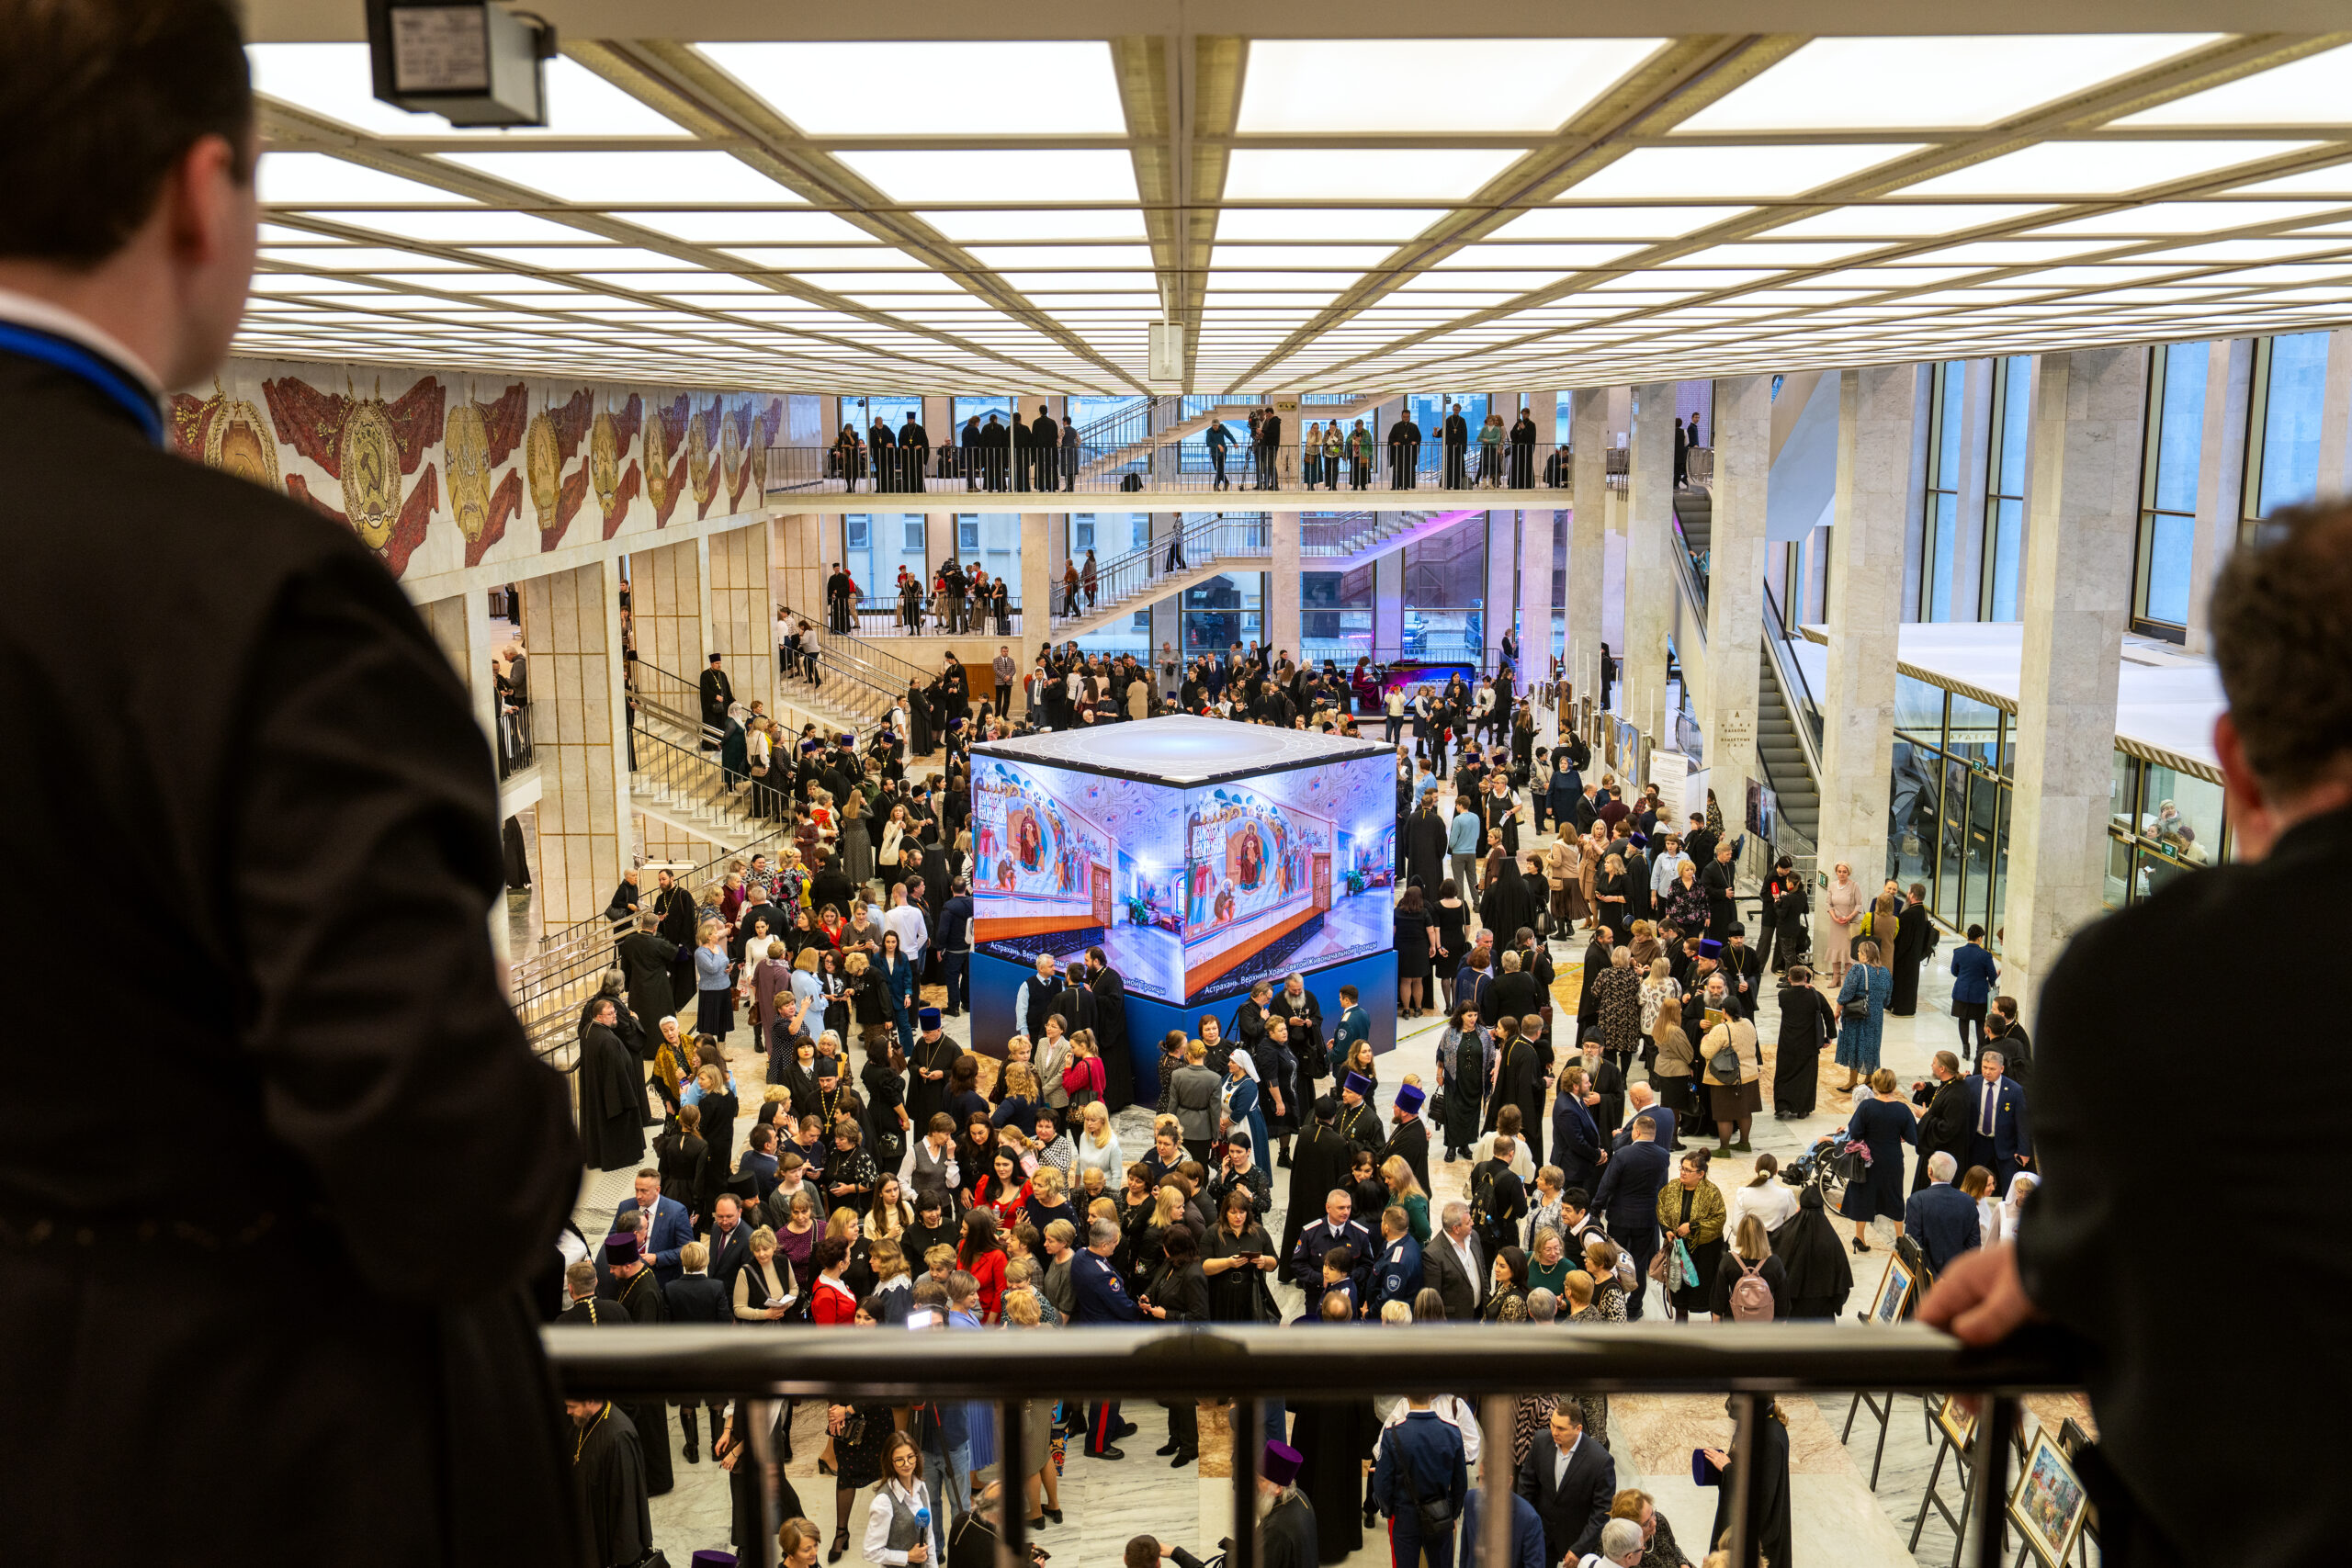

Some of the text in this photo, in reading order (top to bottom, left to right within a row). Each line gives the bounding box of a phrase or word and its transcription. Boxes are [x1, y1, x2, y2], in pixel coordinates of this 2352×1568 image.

[990, 942, 1021, 956] Астрахань.
[1023, 949, 1039, 962] Верх
[1204, 942, 1378, 995] Астрахань. Верхний Храм Святой Живоначальной Троицы
[1139, 979, 1166, 996] Троицы
